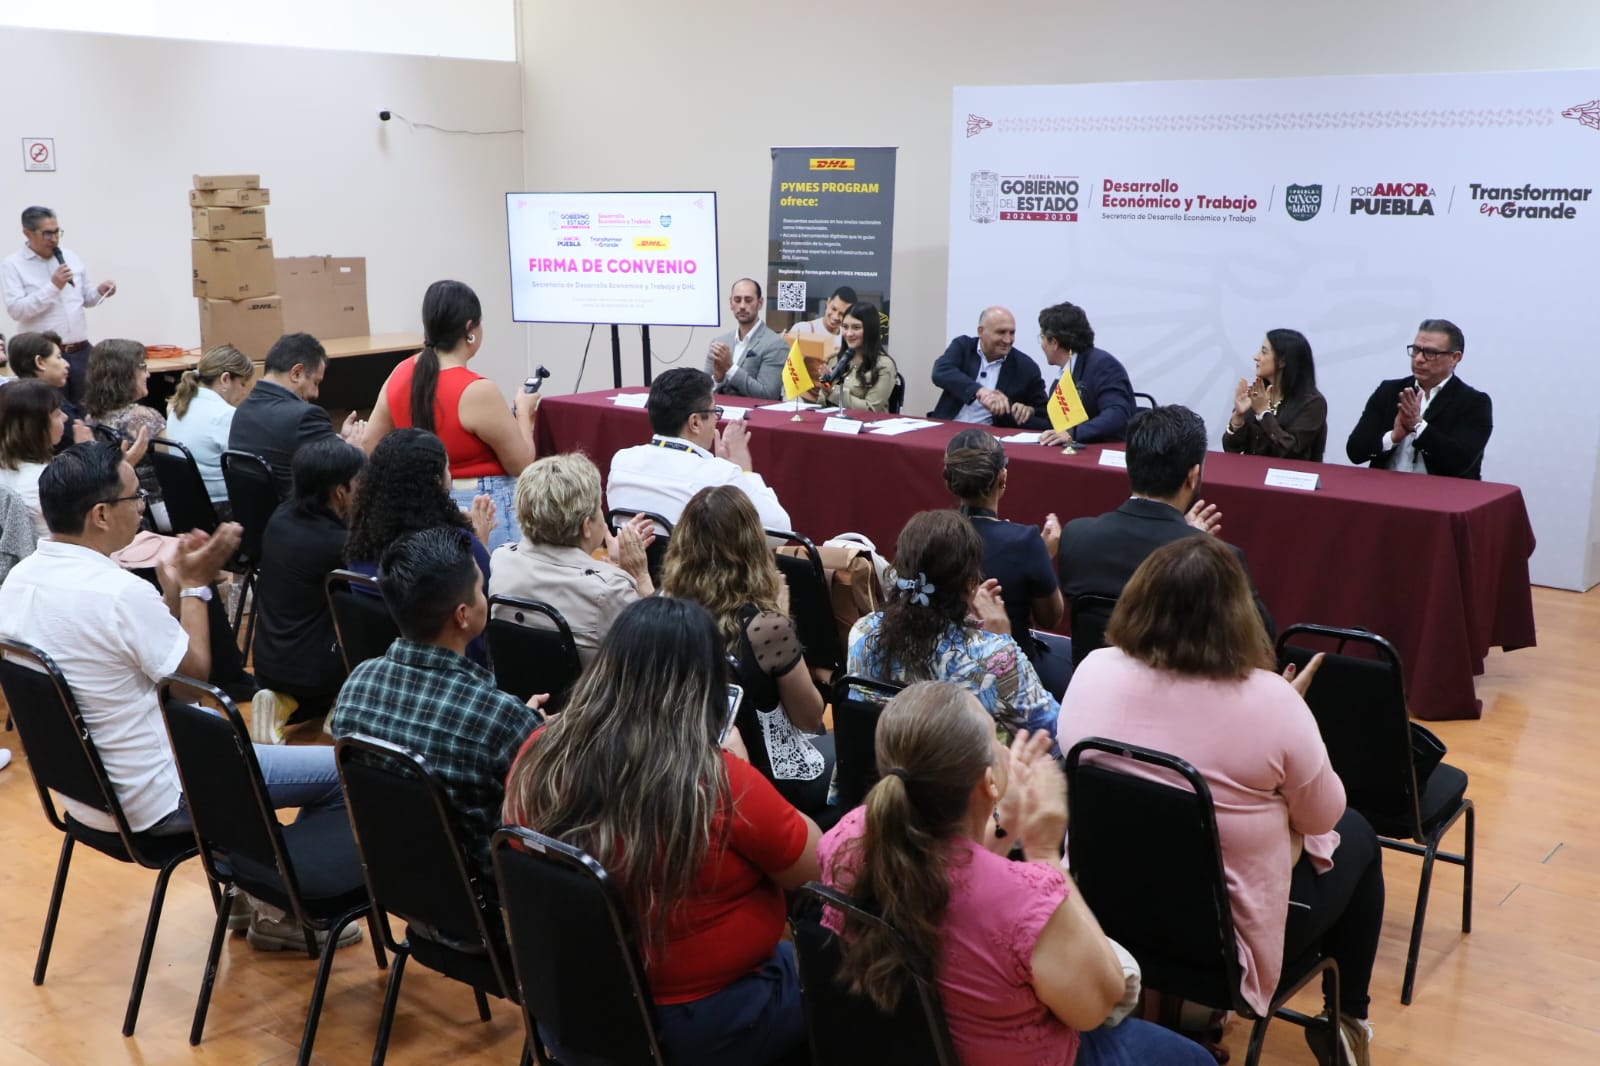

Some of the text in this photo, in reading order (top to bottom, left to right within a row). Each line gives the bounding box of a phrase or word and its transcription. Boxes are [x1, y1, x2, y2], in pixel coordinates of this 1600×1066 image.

[817, 160, 849, 168] DHL
[781, 182, 879, 193] PYMES PROGRAM
[1001, 180, 1079, 195] GOBIERNO
[1103, 179, 1179, 193] Desarrollo
[1351, 182, 1436, 197] POR AMOR A
[1470, 183, 1592, 202] Transformar
[780, 196, 818, 206] ofrece:
[1000, 197, 1079, 212] DEL ESTADO
[1102, 194, 1257, 213] Económico y Trabajo
[1292, 204, 1318, 213] MAYO
[1350, 198, 1435, 216] PUEBLA
[1147, 213, 1182, 221] Desarrollo
[1184, 214, 1221, 222] Económico
[1229, 215, 1257, 223] Trabajo
[1480, 202, 1577, 219] en Grande
[528, 258, 697, 274] FIRMA DE CONVENIO
[1055, 383, 1070, 415] DHL
